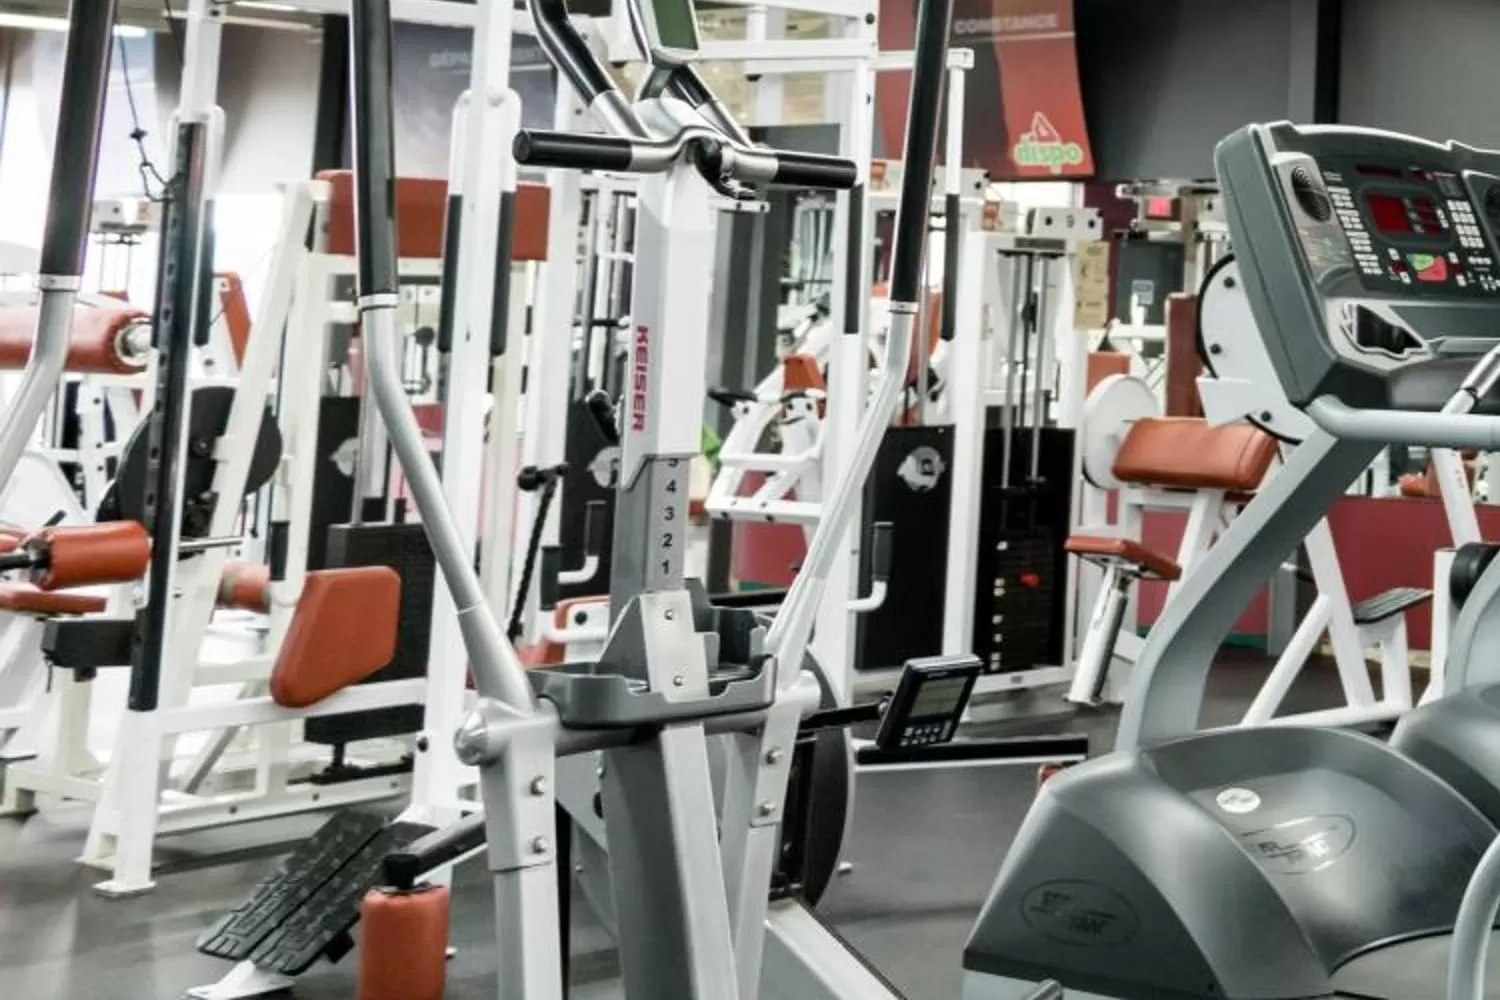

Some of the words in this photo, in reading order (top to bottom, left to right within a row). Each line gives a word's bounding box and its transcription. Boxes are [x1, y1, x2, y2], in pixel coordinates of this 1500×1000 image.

[954, 13, 1058, 35] CONSTANCE
[1015, 134, 1083, 174] dispo
[632, 325, 649, 431] KEISER
[665, 479, 677, 494] 4
[663, 506, 675, 521] 3
[662, 533, 673, 549] 2
[661, 559, 670, 575] 1
